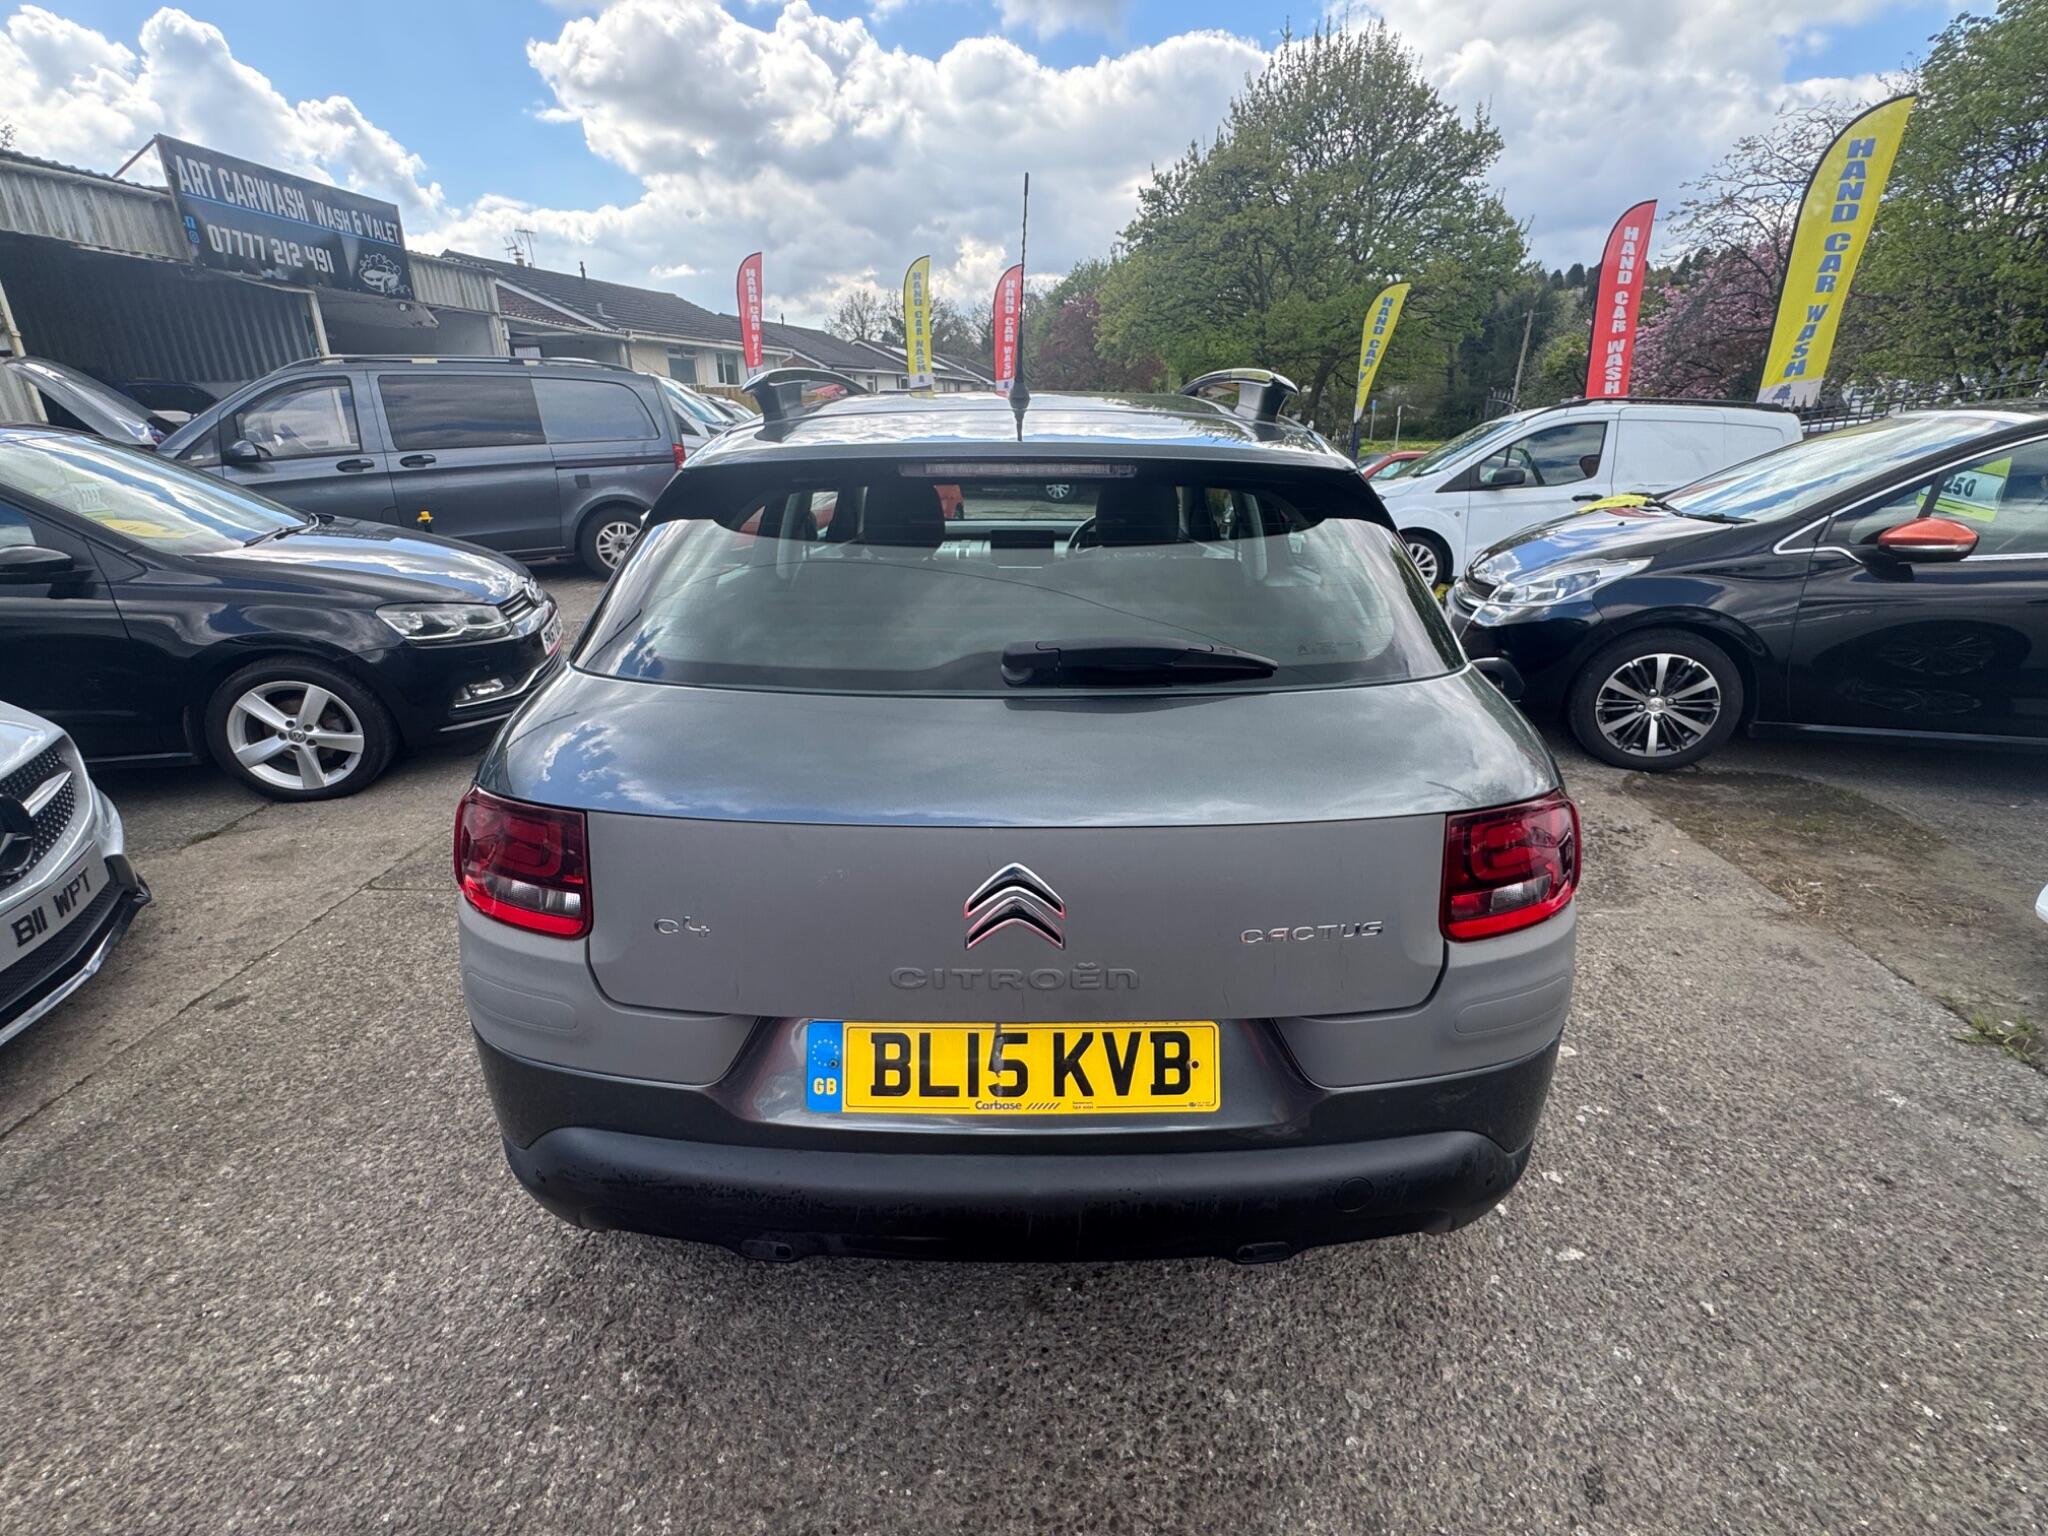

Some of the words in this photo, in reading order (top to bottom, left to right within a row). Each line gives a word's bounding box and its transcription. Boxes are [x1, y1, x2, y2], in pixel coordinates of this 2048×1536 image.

[175, 154, 217, 200] ART
[217, 167, 309, 222] CARWASH
[363, 212, 400, 244] VALET
[1830, 137, 1876, 223] HAND
[206, 223, 267, 261] 07777
[1617, 226, 1640, 285] HAND
[1814, 232, 1851, 294] CAR
[1373, 296, 1394, 335] HAND
[1612, 291, 1630, 333] CAR
[1604, 338, 1626, 395] WASH
[1783, 304, 1829, 378] WASH
[53, 866, 91, 918] WPT
[654, 915, 711, 938] C4
[1240, 920, 1383, 944] CACTUS
[812, 1077, 838, 1096] GB
[1052, 1030, 1192, 1097] KVB
[974, 1100, 1023, 1111] Carbase
